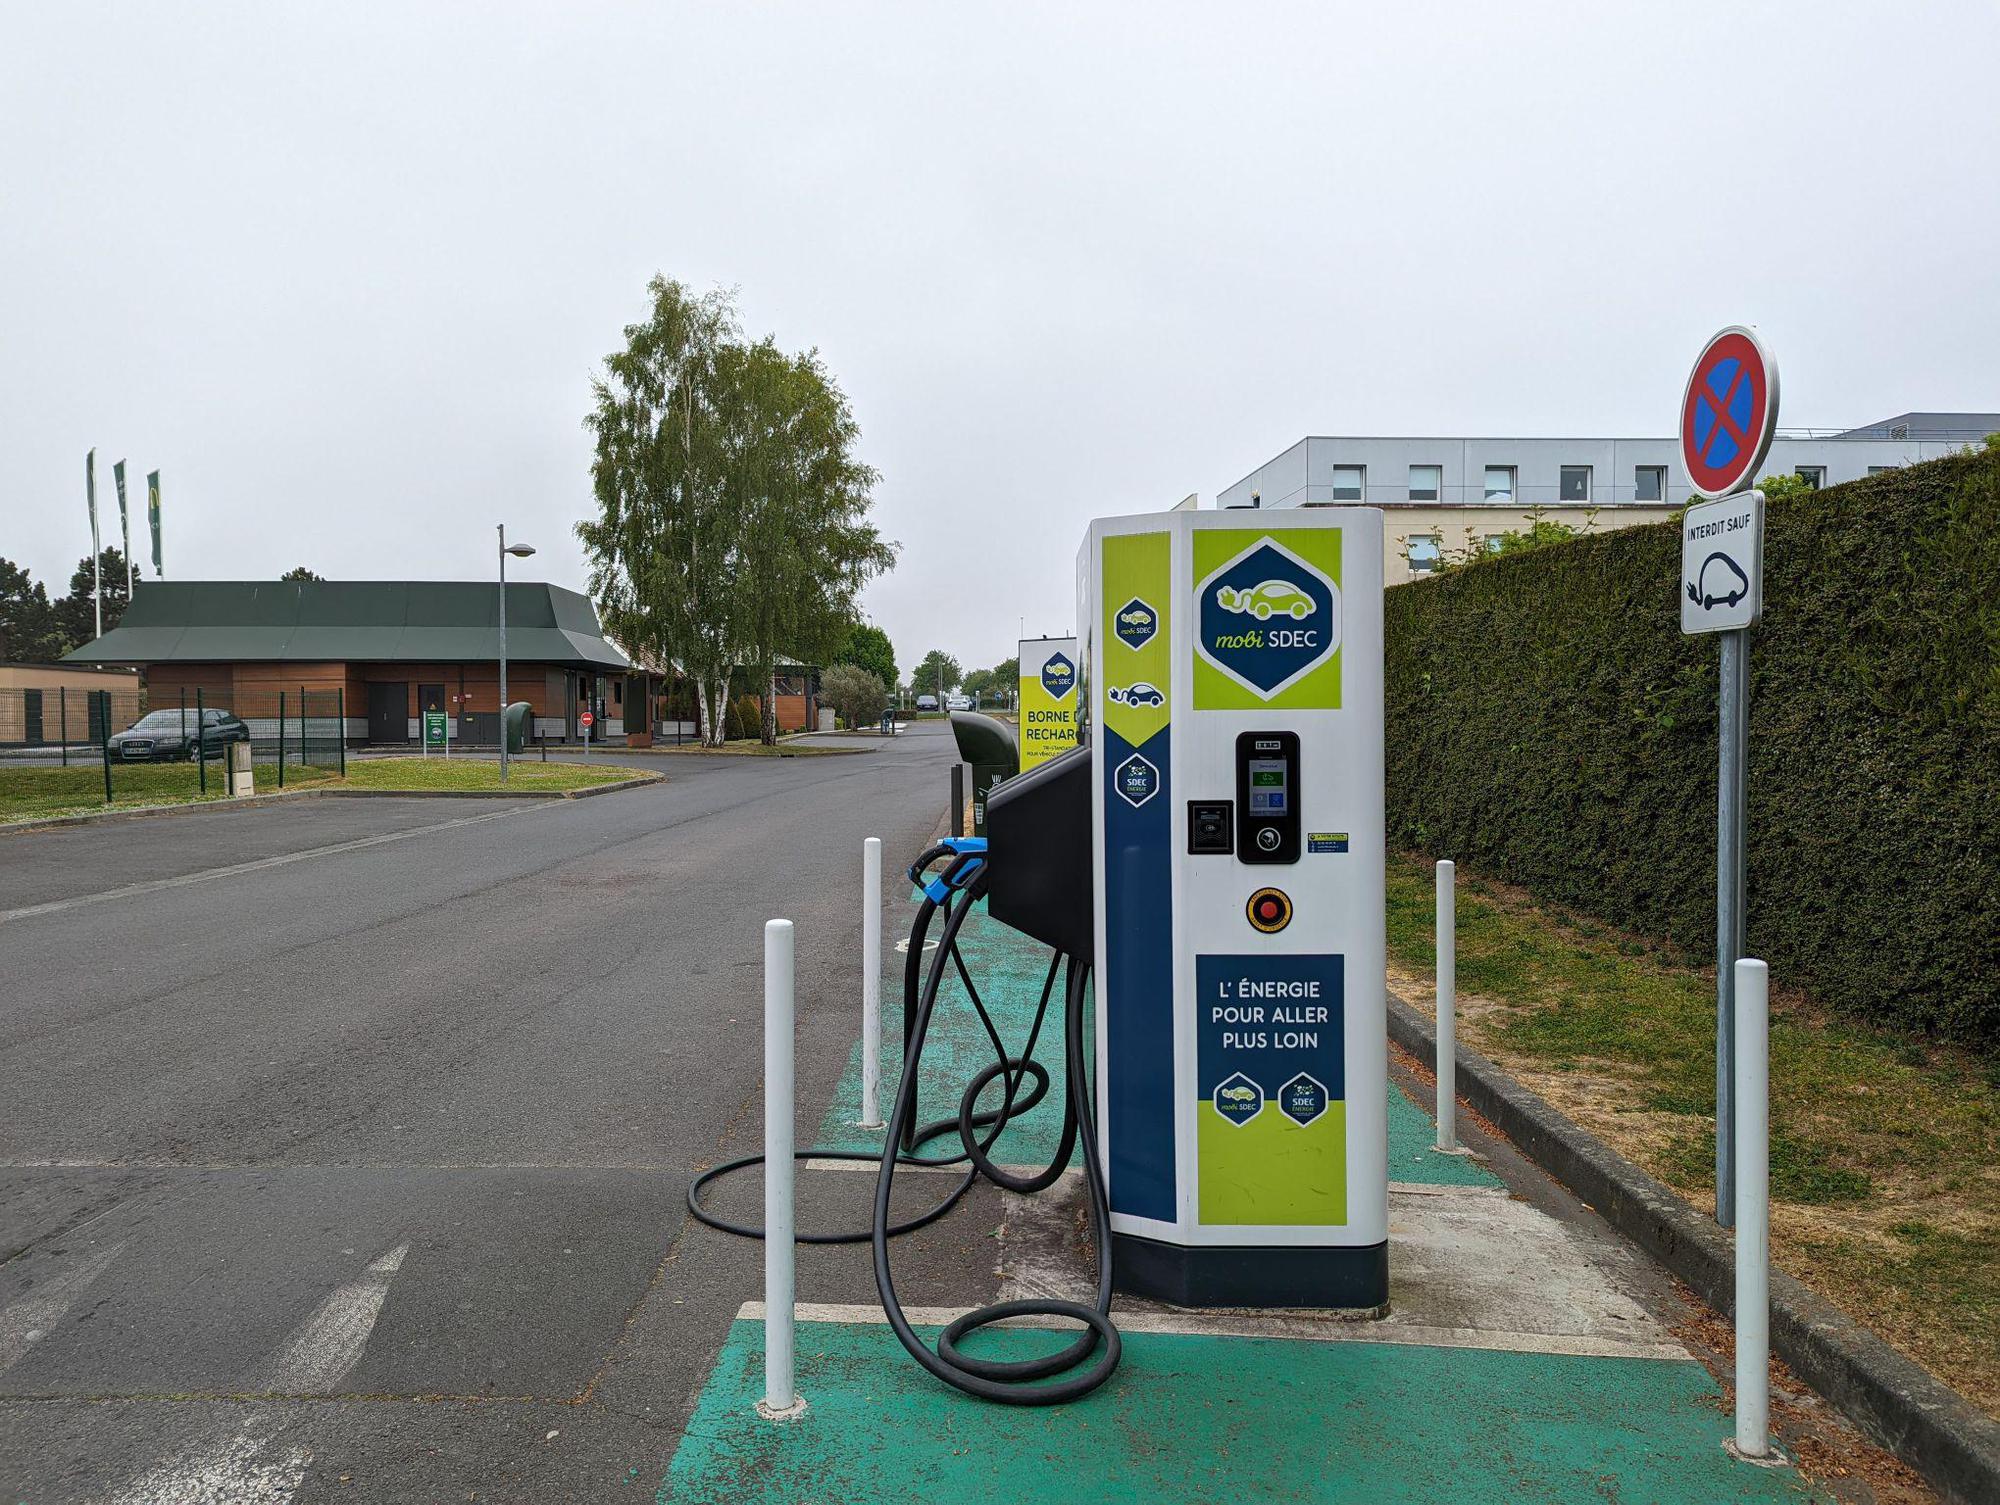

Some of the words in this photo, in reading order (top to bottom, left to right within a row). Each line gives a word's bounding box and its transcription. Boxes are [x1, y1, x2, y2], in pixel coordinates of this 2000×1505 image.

[1687, 520, 1725, 541] INTERDIT
[1727, 514, 1751, 532] SAUF
[1136, 626, 1151, 634] SDEC
[1215, 630, 1264, 648] mobi
[1268, 630, 1317, 648] SDEC
[1028, 711, 1070, 723] BORNE
[1127, 778, 1147, 787] SDEC
[1219, 982, 1231, 998] L'
[1239, 977, 1320, 998] ÉNERGIE
[1212, 1007, 1264, 1023] POUR
[1272, 1007, 1328, 1023] ALLER
[1223, 1032, 1268, 1048] PLUS
[1274, 1032, 1318, 1048] LOIN
[1238, 1103, 1256, 1111] SDEC
[1292, 1097, 1314, 1106] SDEC
